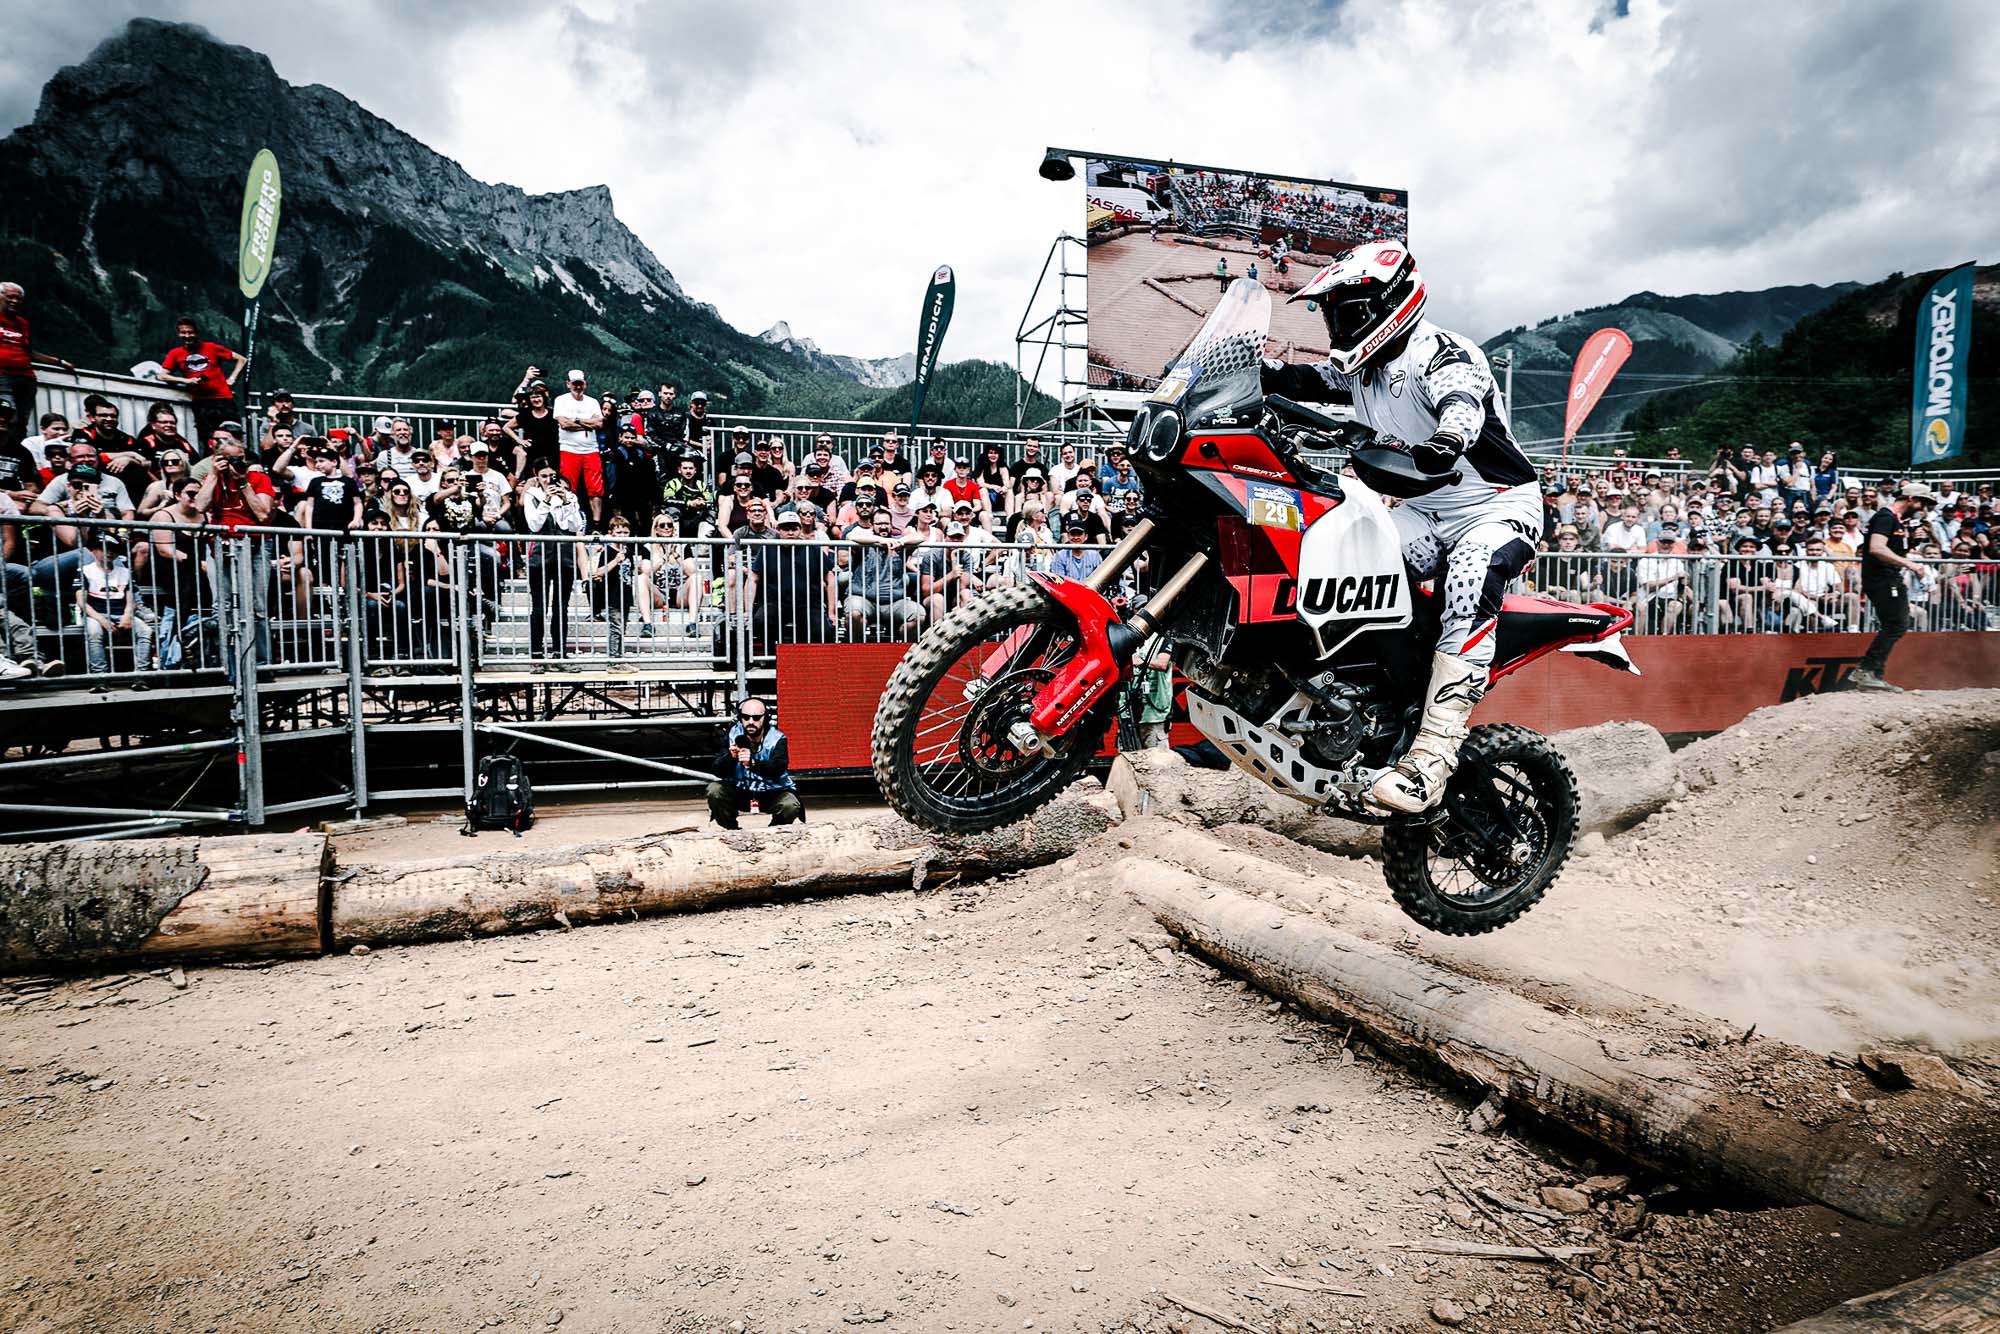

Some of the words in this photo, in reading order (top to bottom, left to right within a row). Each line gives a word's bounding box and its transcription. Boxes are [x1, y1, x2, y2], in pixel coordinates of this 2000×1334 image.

[257, 187, 278, 263] LEOBEN
[1381, 268, 1407, 300] DUCATI
[1365, 319, 1399, 353] DUCATI
[1925, 287, 1958, 417] MOTOREX
[1265, 502, 1288, 524] 29
[1272, 573, 1400, 615] DUCATI
[1056, 685, 1097, 726] METZELER
